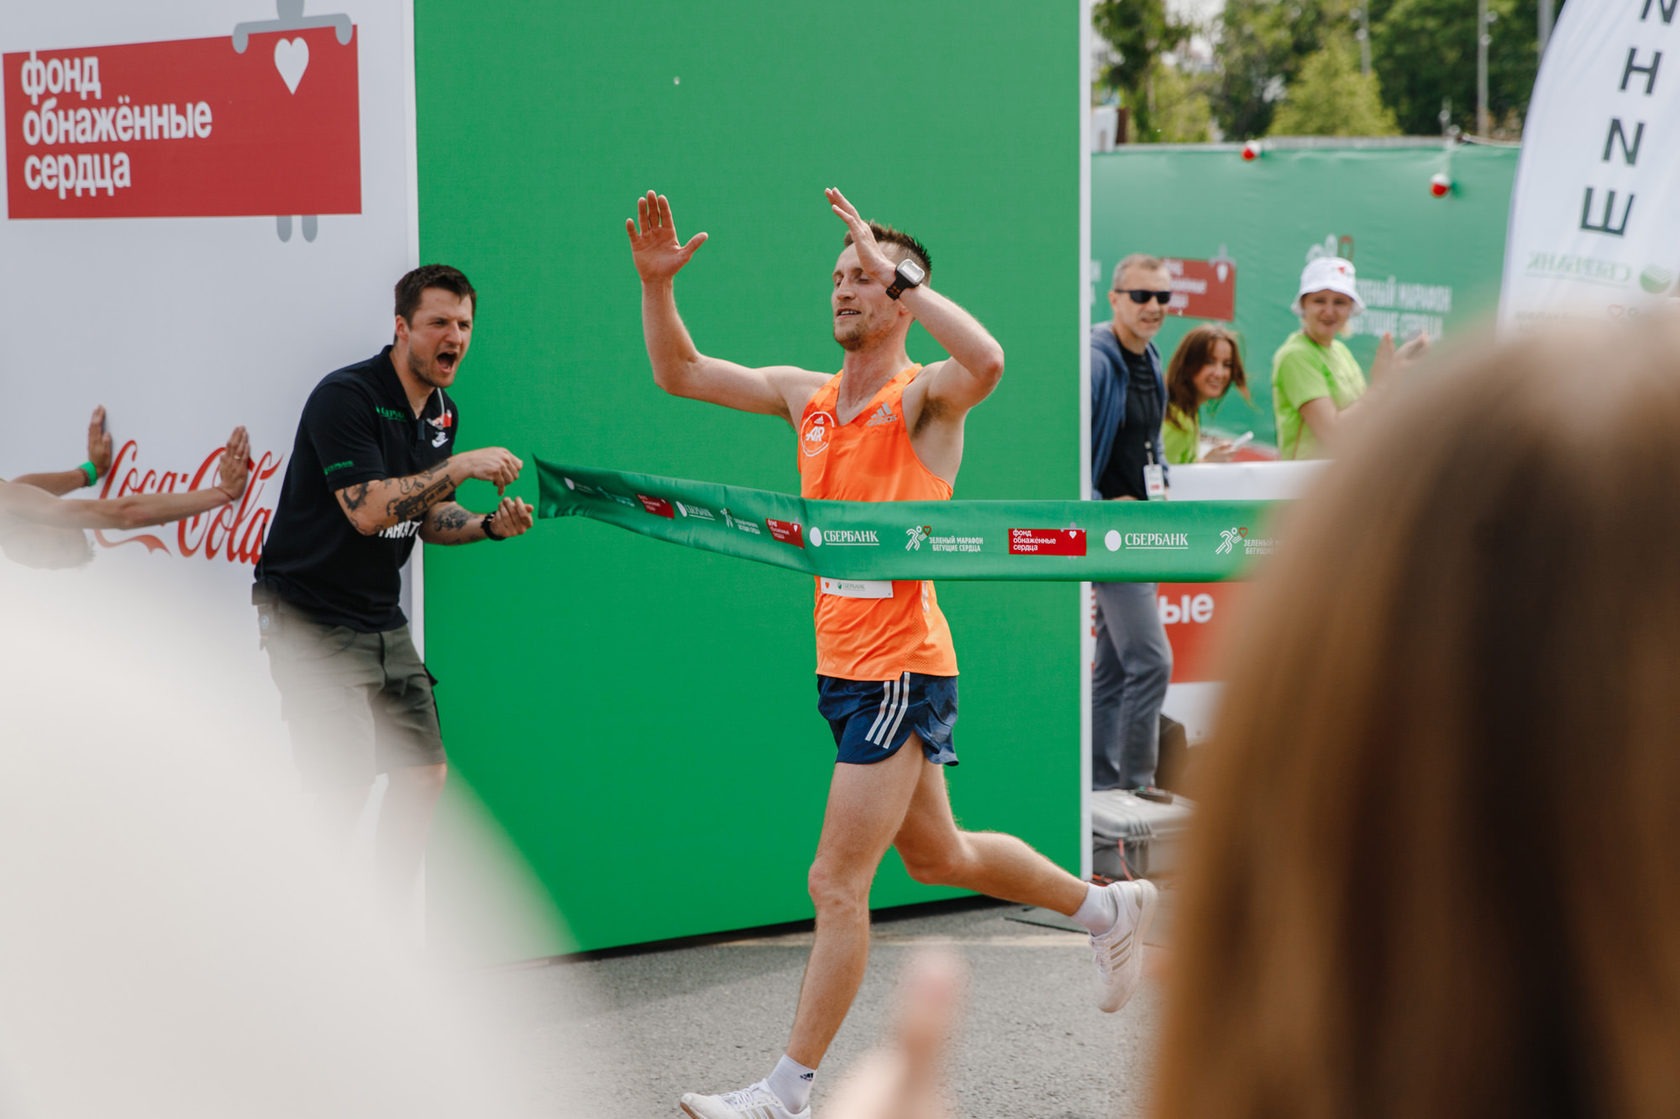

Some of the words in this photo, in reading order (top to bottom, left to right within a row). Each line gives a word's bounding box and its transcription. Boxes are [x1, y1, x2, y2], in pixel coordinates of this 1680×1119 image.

[21, 49, 102, 105] фонд
[23, 95, 213, 145] обнажённые
[24, 152, 131, 200] сердца
[823, 530, 879, 543] СБЕРБАНК
[1012, 529, 1032, 537] фонд
[1125, 533, 1189, 546] СБЕРБАНК
[956, 537, 984, 545] МАРАФОН
[1013, 544, 1039, 552] сердца
